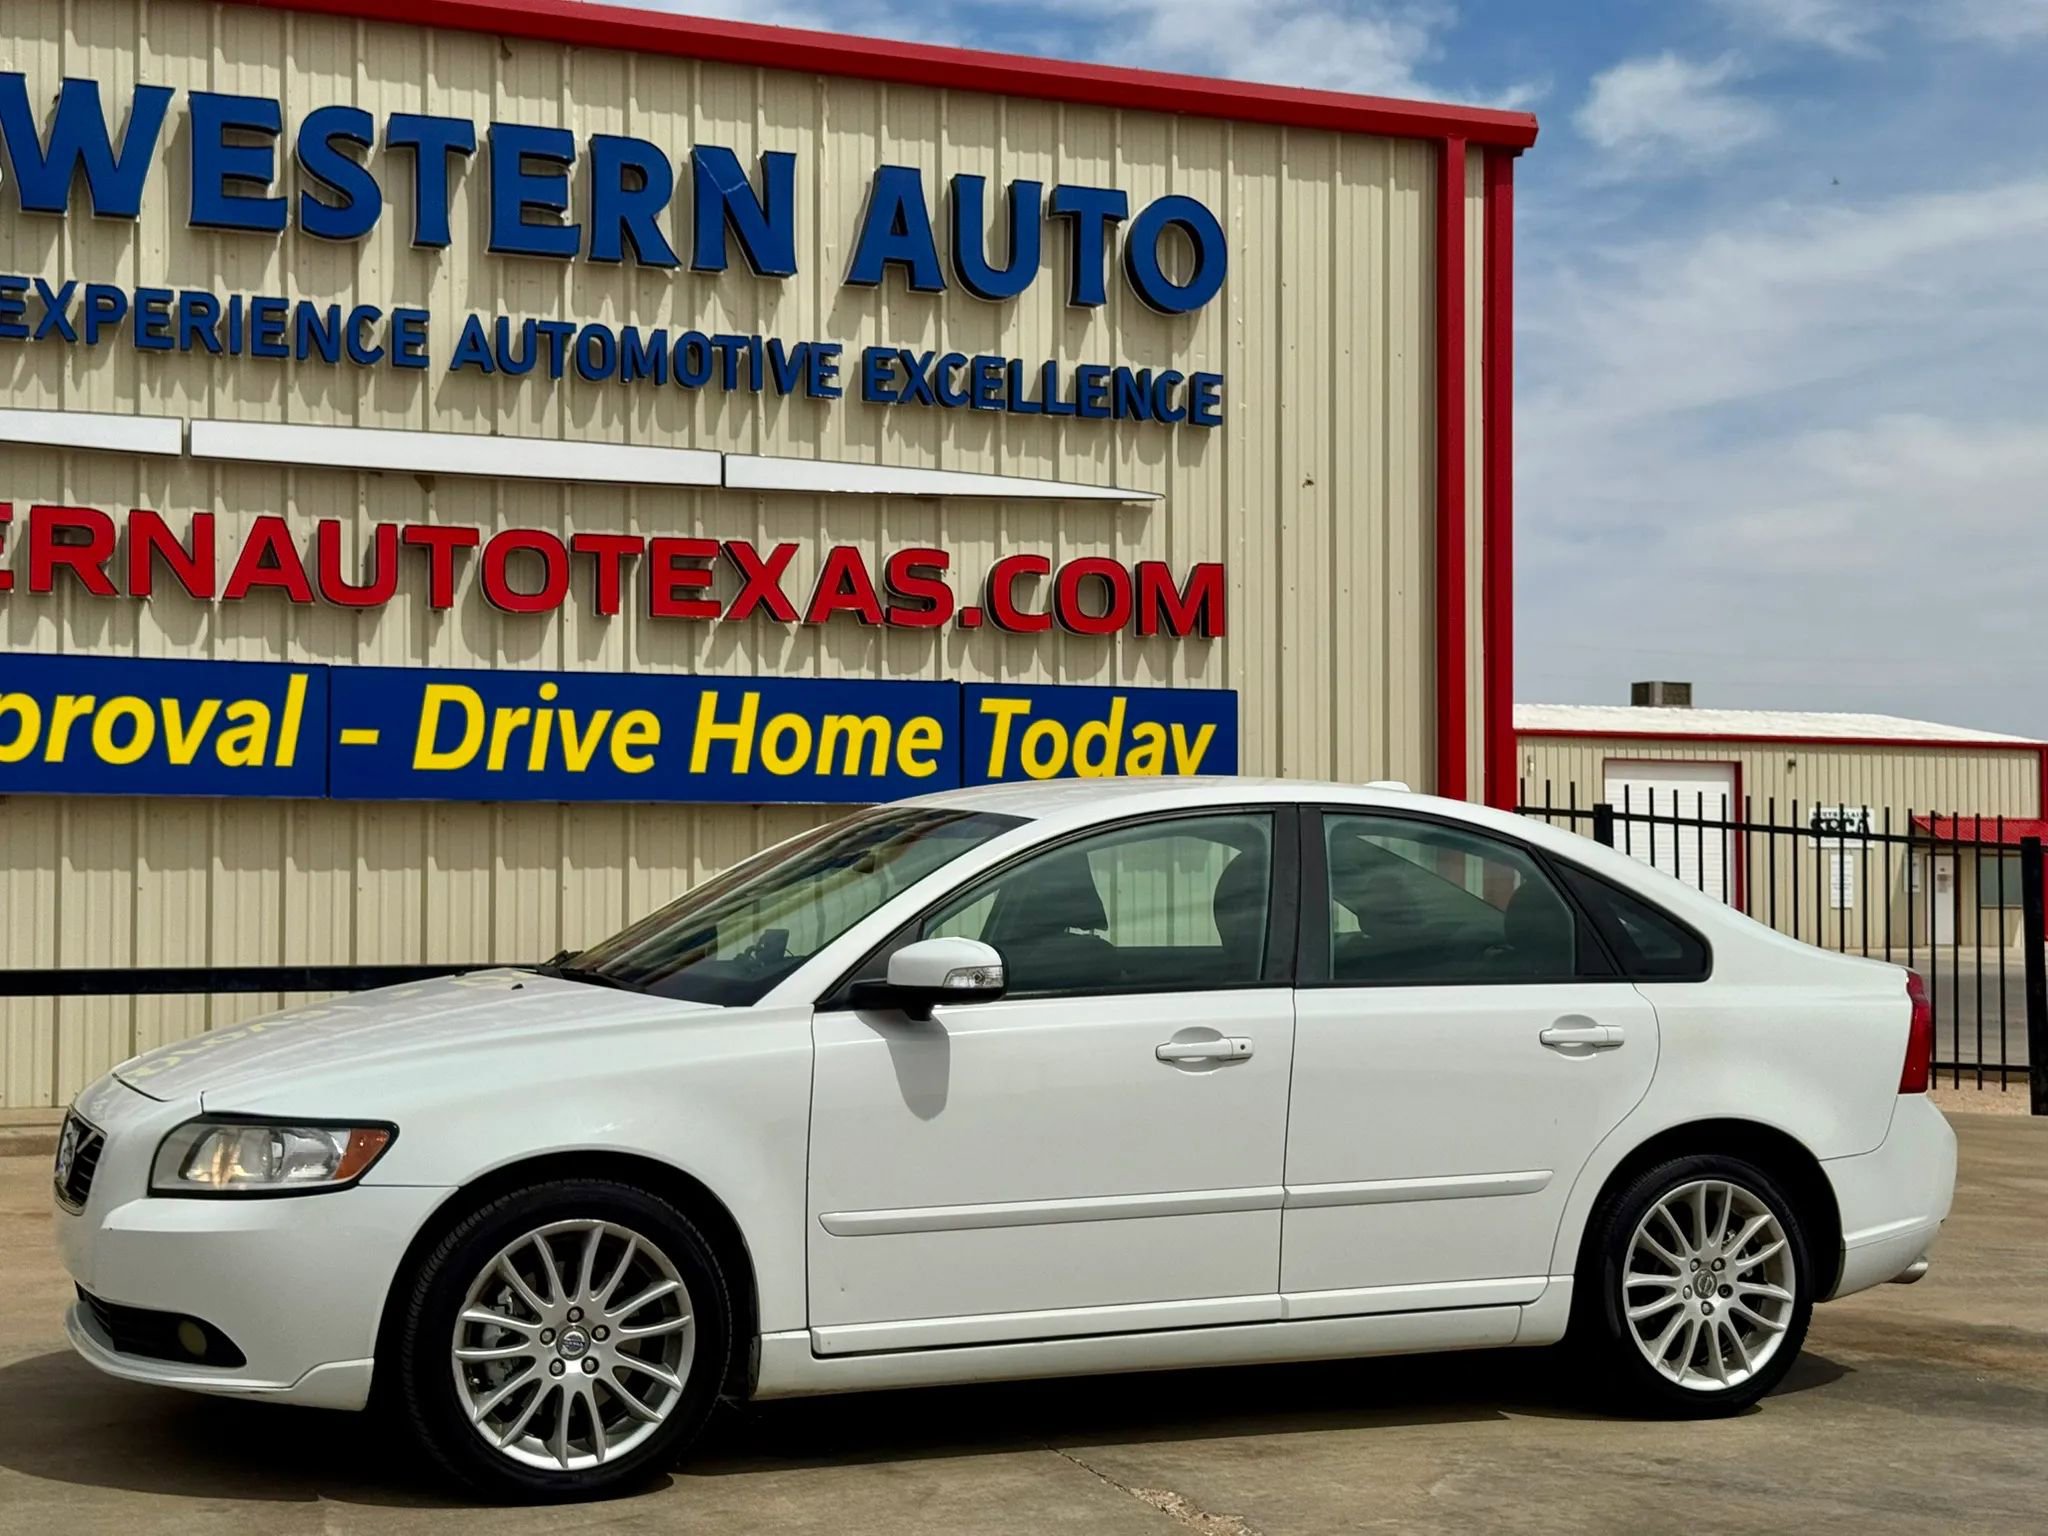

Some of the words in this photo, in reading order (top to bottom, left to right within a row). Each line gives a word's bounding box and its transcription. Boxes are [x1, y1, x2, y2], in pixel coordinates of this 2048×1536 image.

[845, 165, 1227, 313] AUTO
[0, 275, 430, 368] EXPERIENCE
[450, 313, 843, 398] AUTOMOTIVE
[863, 346, 1224, 426] EXCELLENCE
[0, 502, 1226, 638] RNAUTOTEXAS.COM
[412, 682, 661, 774] Drive
[689, 690, 943, 777] Home
